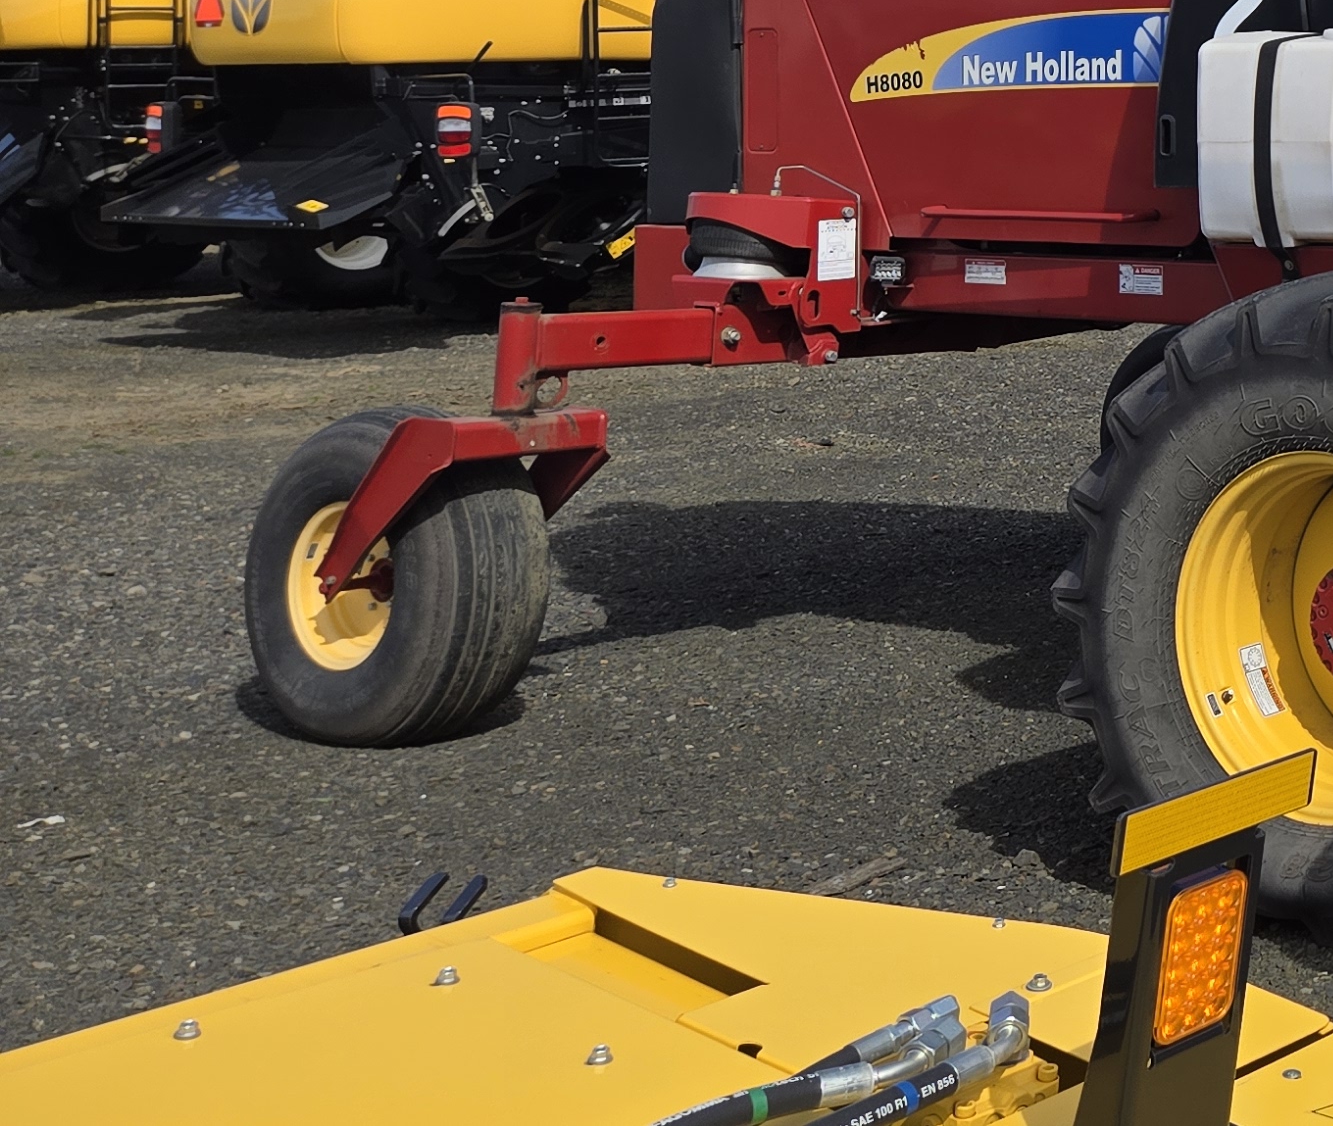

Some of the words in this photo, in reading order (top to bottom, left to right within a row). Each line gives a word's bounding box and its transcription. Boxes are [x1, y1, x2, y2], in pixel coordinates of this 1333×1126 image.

[866, 70, 923, 93] H8080
[962, 55, 1017, 85] New
[1026, 50, 1122, 82] Holland
[851, 1111, 875, 1126] SAE
[875, 1103, 893, 1119] 100
[921, 1082, 936, 1098] EN
[937, 1074, 955, 1090] 856
